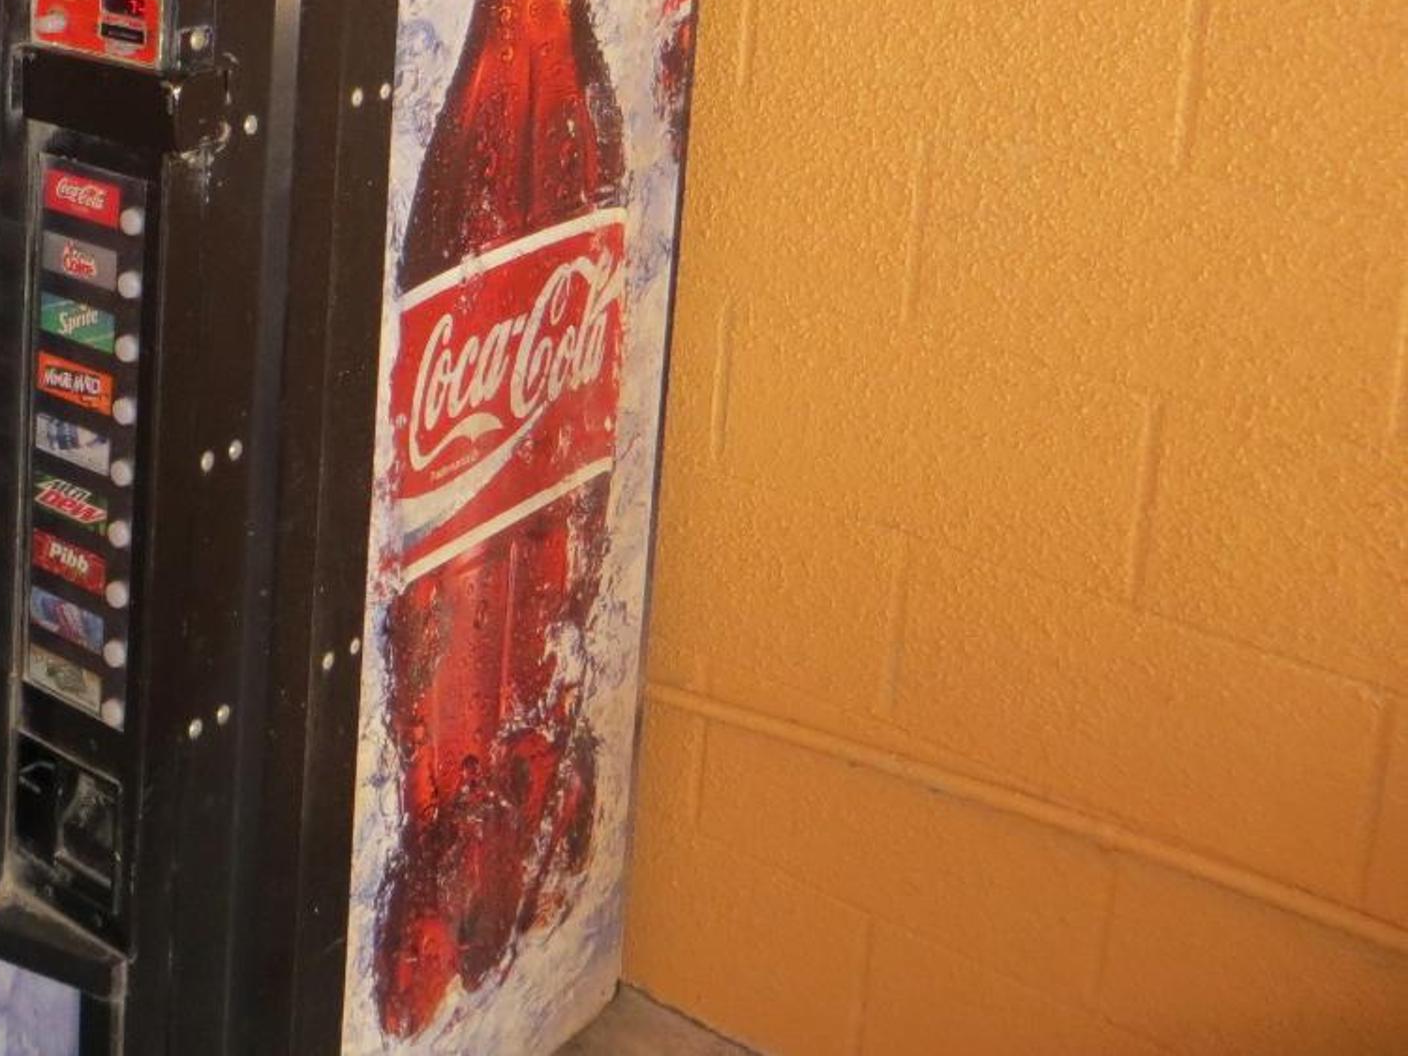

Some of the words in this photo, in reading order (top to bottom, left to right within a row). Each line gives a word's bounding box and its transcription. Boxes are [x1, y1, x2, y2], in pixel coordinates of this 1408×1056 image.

[55, 176, 108, 210] Coca-Cola
[58, 303, 99, 336] Sprite
[408, 244, 626, 472] Coca-Cola
[49, 542, 90, 575] Pibb
